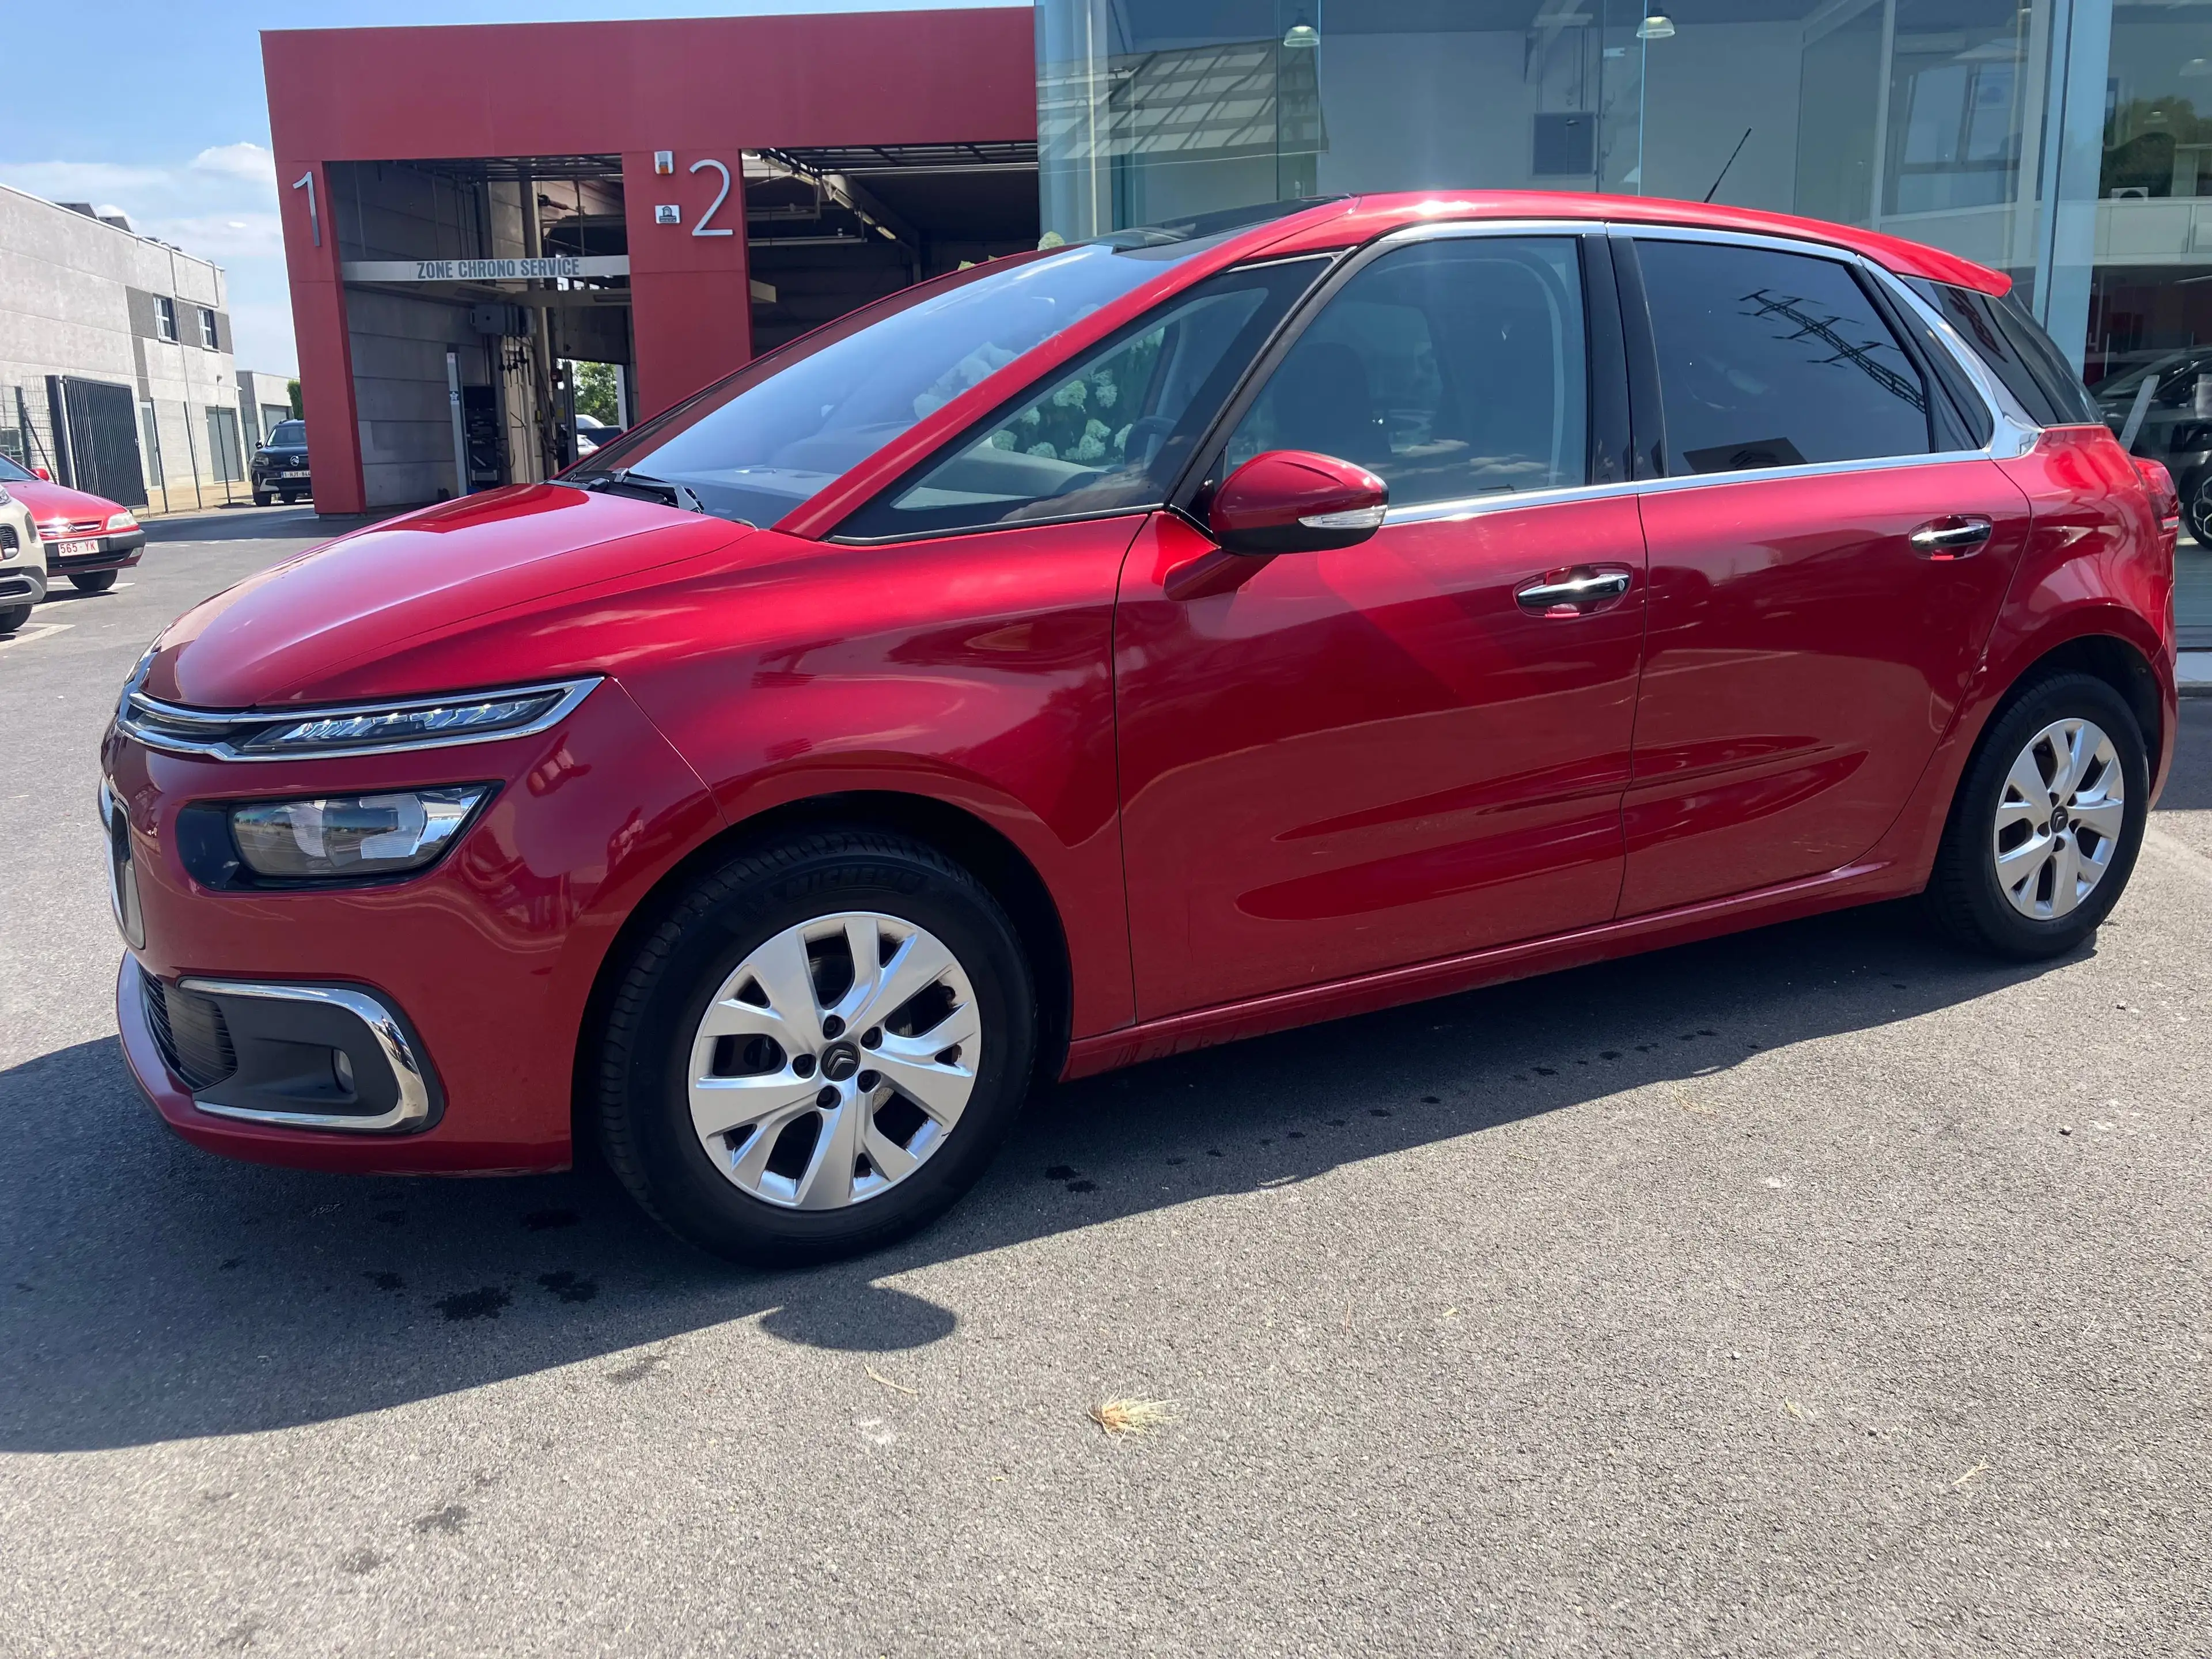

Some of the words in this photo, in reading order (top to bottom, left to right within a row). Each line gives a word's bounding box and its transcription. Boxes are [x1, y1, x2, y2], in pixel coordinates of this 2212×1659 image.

[292, 171, 320, 247] 1
[689, 158, 733, 236] 2
[416, 262, 453, 279] ZONE
[458, 259, 516, 278] CHRONO
[520, 258, 580, 276] SERVICE
[786, 867, 924, 899] MICHELIN
